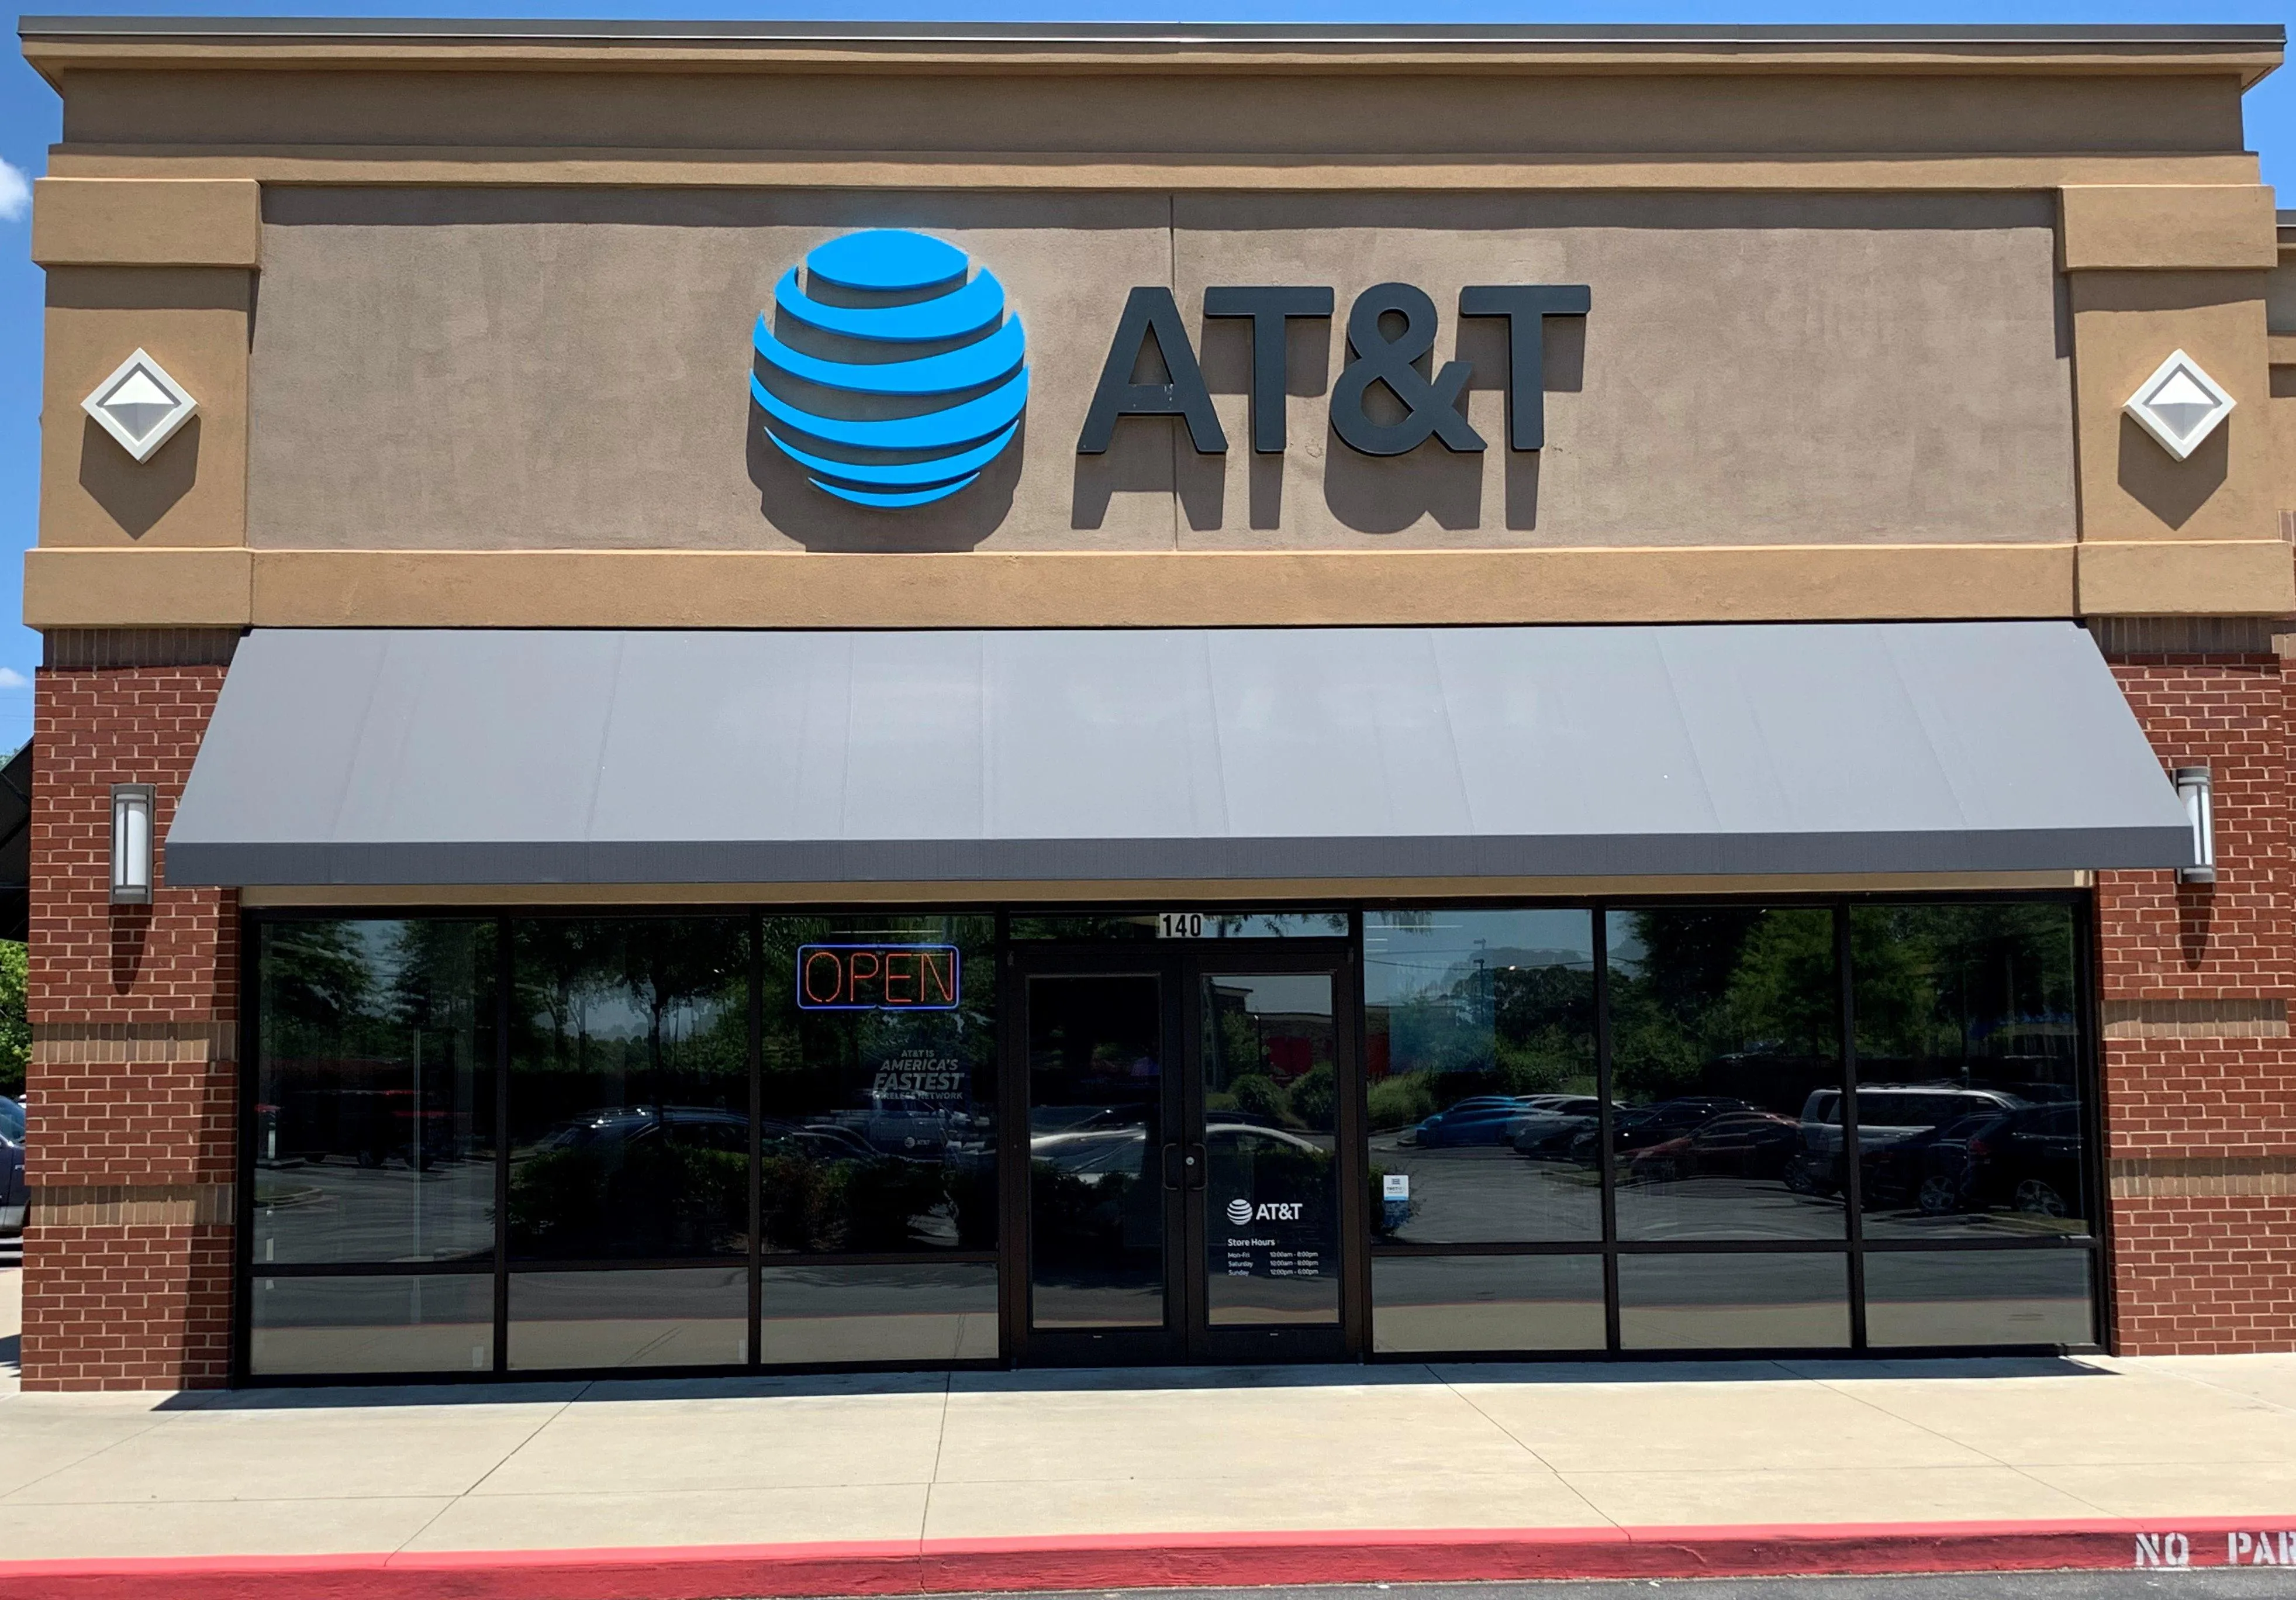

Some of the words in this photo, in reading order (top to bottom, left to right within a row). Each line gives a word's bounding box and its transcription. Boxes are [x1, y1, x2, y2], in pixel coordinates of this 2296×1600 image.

[1077, 282, 1591, 456] AT&T
[1163, 914, 1201, 937] 140
[806, 951, 954, 1002] OPEN
[880, 1059, 959, 1071] AMERICA'S
[873, 1073, 965, 1090] FASTEST
[1255, 1203, 1303, 1220] AT&T
[2136, 1532, 2189, 1566] NO
